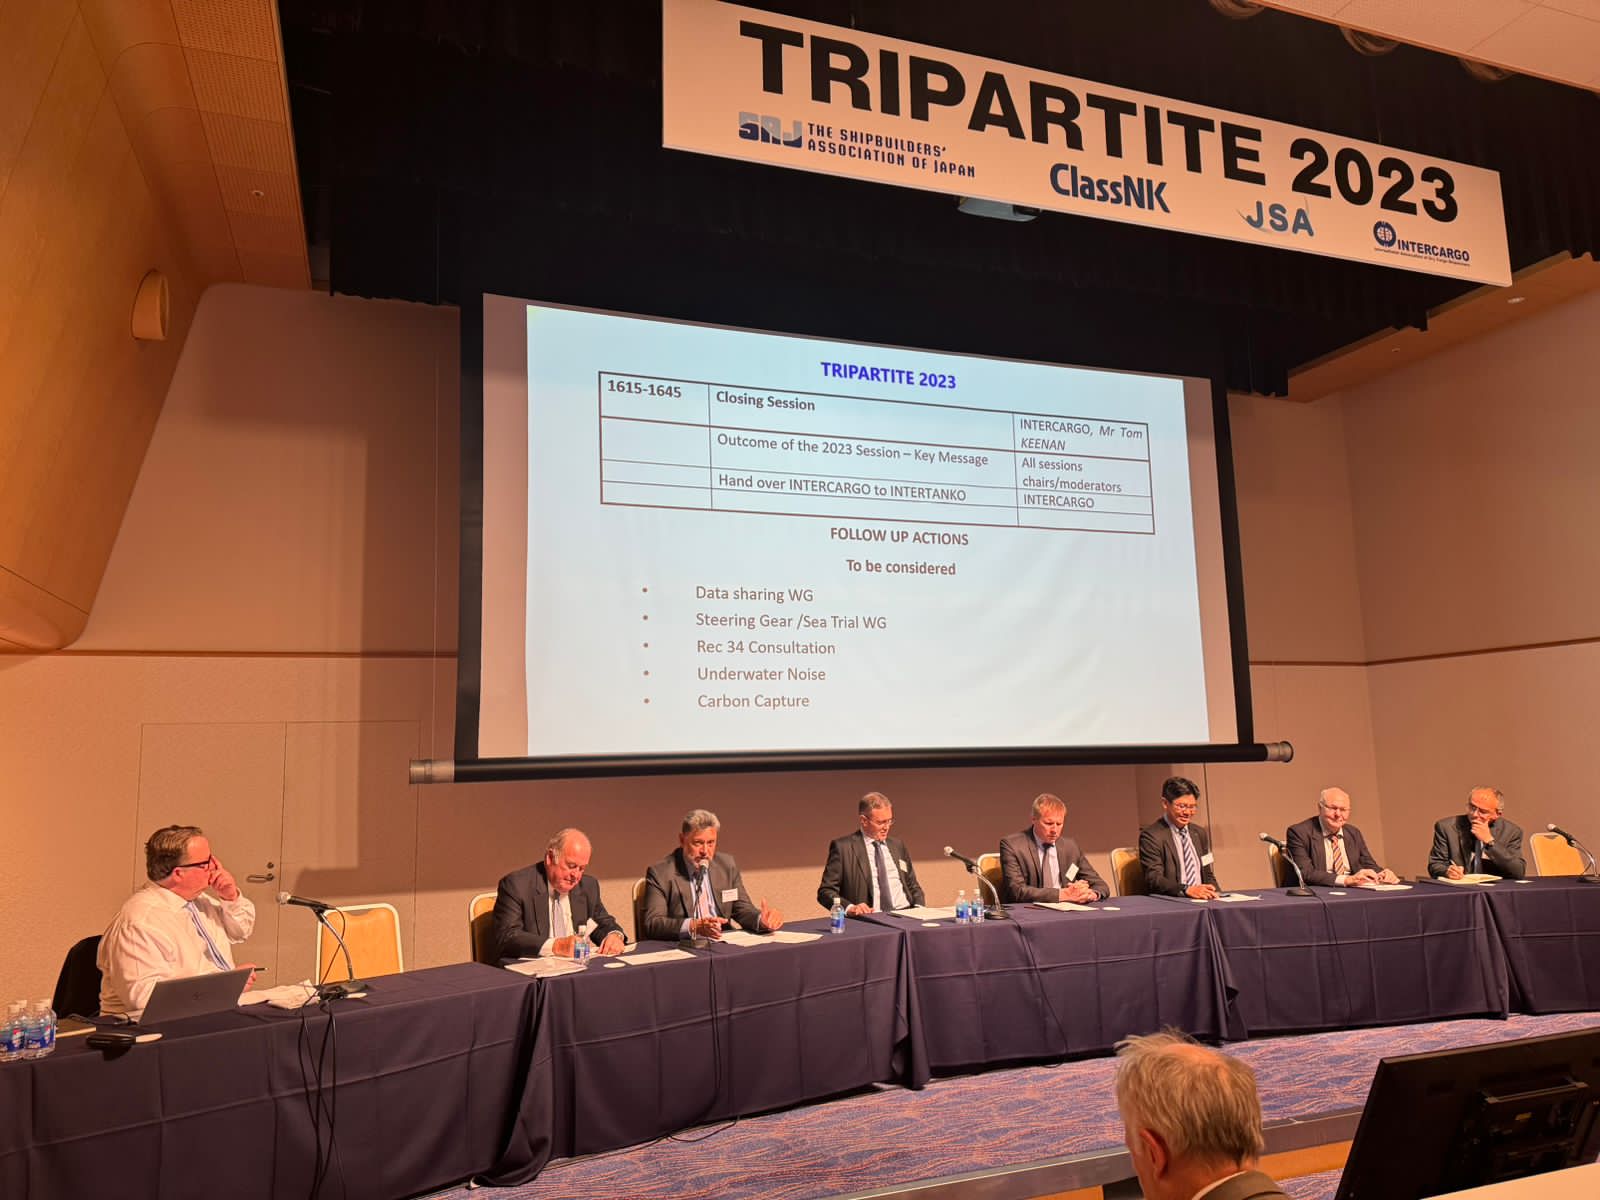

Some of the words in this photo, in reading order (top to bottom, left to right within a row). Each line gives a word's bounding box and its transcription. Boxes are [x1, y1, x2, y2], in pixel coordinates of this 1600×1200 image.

[739, 20, 1266, 186] TRIPARTITE
[1290, 138, 1459, 223] 2023
[808, 122, 833, 139] THE
[808, 138, 905, 167] ASSOCIATION
[912, 156, 928, 170] OF
[934, 160, 976, 178] JAPAN
[1050, 162, 1171, 214] ClassNK
[1245, 200, 1314, 237] JSA
[1397, 239, 1470, 262] INTERCARGO
[821, 361, 915, 386] TRIPARTITE
[919, 372, 957, 389] 2023
[607, 379, 682, 398] 1615-1645
[716, 390, 765, 408] Closing
[767, 395, 816, 411] Session
[1020, 418, 1094, 437] INTERCARGO,
[1099, 425, 1115, 437] Mr
[1120, 426, 1143, 439] Tom
[717, 433, 778, 450] Outcome
[781, 438, 796, 451] of
[798, 439, 819, 453] the
[822, 442, 853, 456] 2023
[856, 443, 900, 459] Session
[914, 448, 936, 464] Key
[939, 450, 989, 467] Message
[1021, 438, 1066, 451] KEENAN
[1022, 457, 1037, 470] All
[1039, 458, 1083, 472] sessions
[719, 474, 753, 488] Hand
[757, 478, 786, 490] over
[789, 478, 871, 495] INTERCARGO
[874, 484, 888, 496] to
[890, 485, 967, 502] INTERTANKO
[1022, 475, 1122, 493] chairs/moderators
[1023, 493, 1095, 509] INTERCARGO
[830, 527, 887, 542] FOLLOW
[890, 529, 910, 543] UP
[912, 530, 969, 546] ACTIONS
[846, 559, 862, 572] To
[865, 559, 882, 573] be
[885, 560, 956, 576] considered
[696, 585, 729, 600] Data
[733, 587, 784, 604] sharing
[788, 588, 814, 602] WG
[696, 612, 756, 630] Steering
[759, 614, 793, 628] Gear
[796, 613, 827, 630] /Sea
[831, 615, 859, 629] Trial
[863, 616, 887, 629] WG
[697, 640, 722, 653] Rec
[727, 640, 745, 653] 34
[749, 640, 836, 655] Consultation
[697, 667, 784, 681] Underwater
[787, 667, 826, 681] Noise
[698, 694, 750, 708] Carbon
[754, 694, 810, 710] Capture
